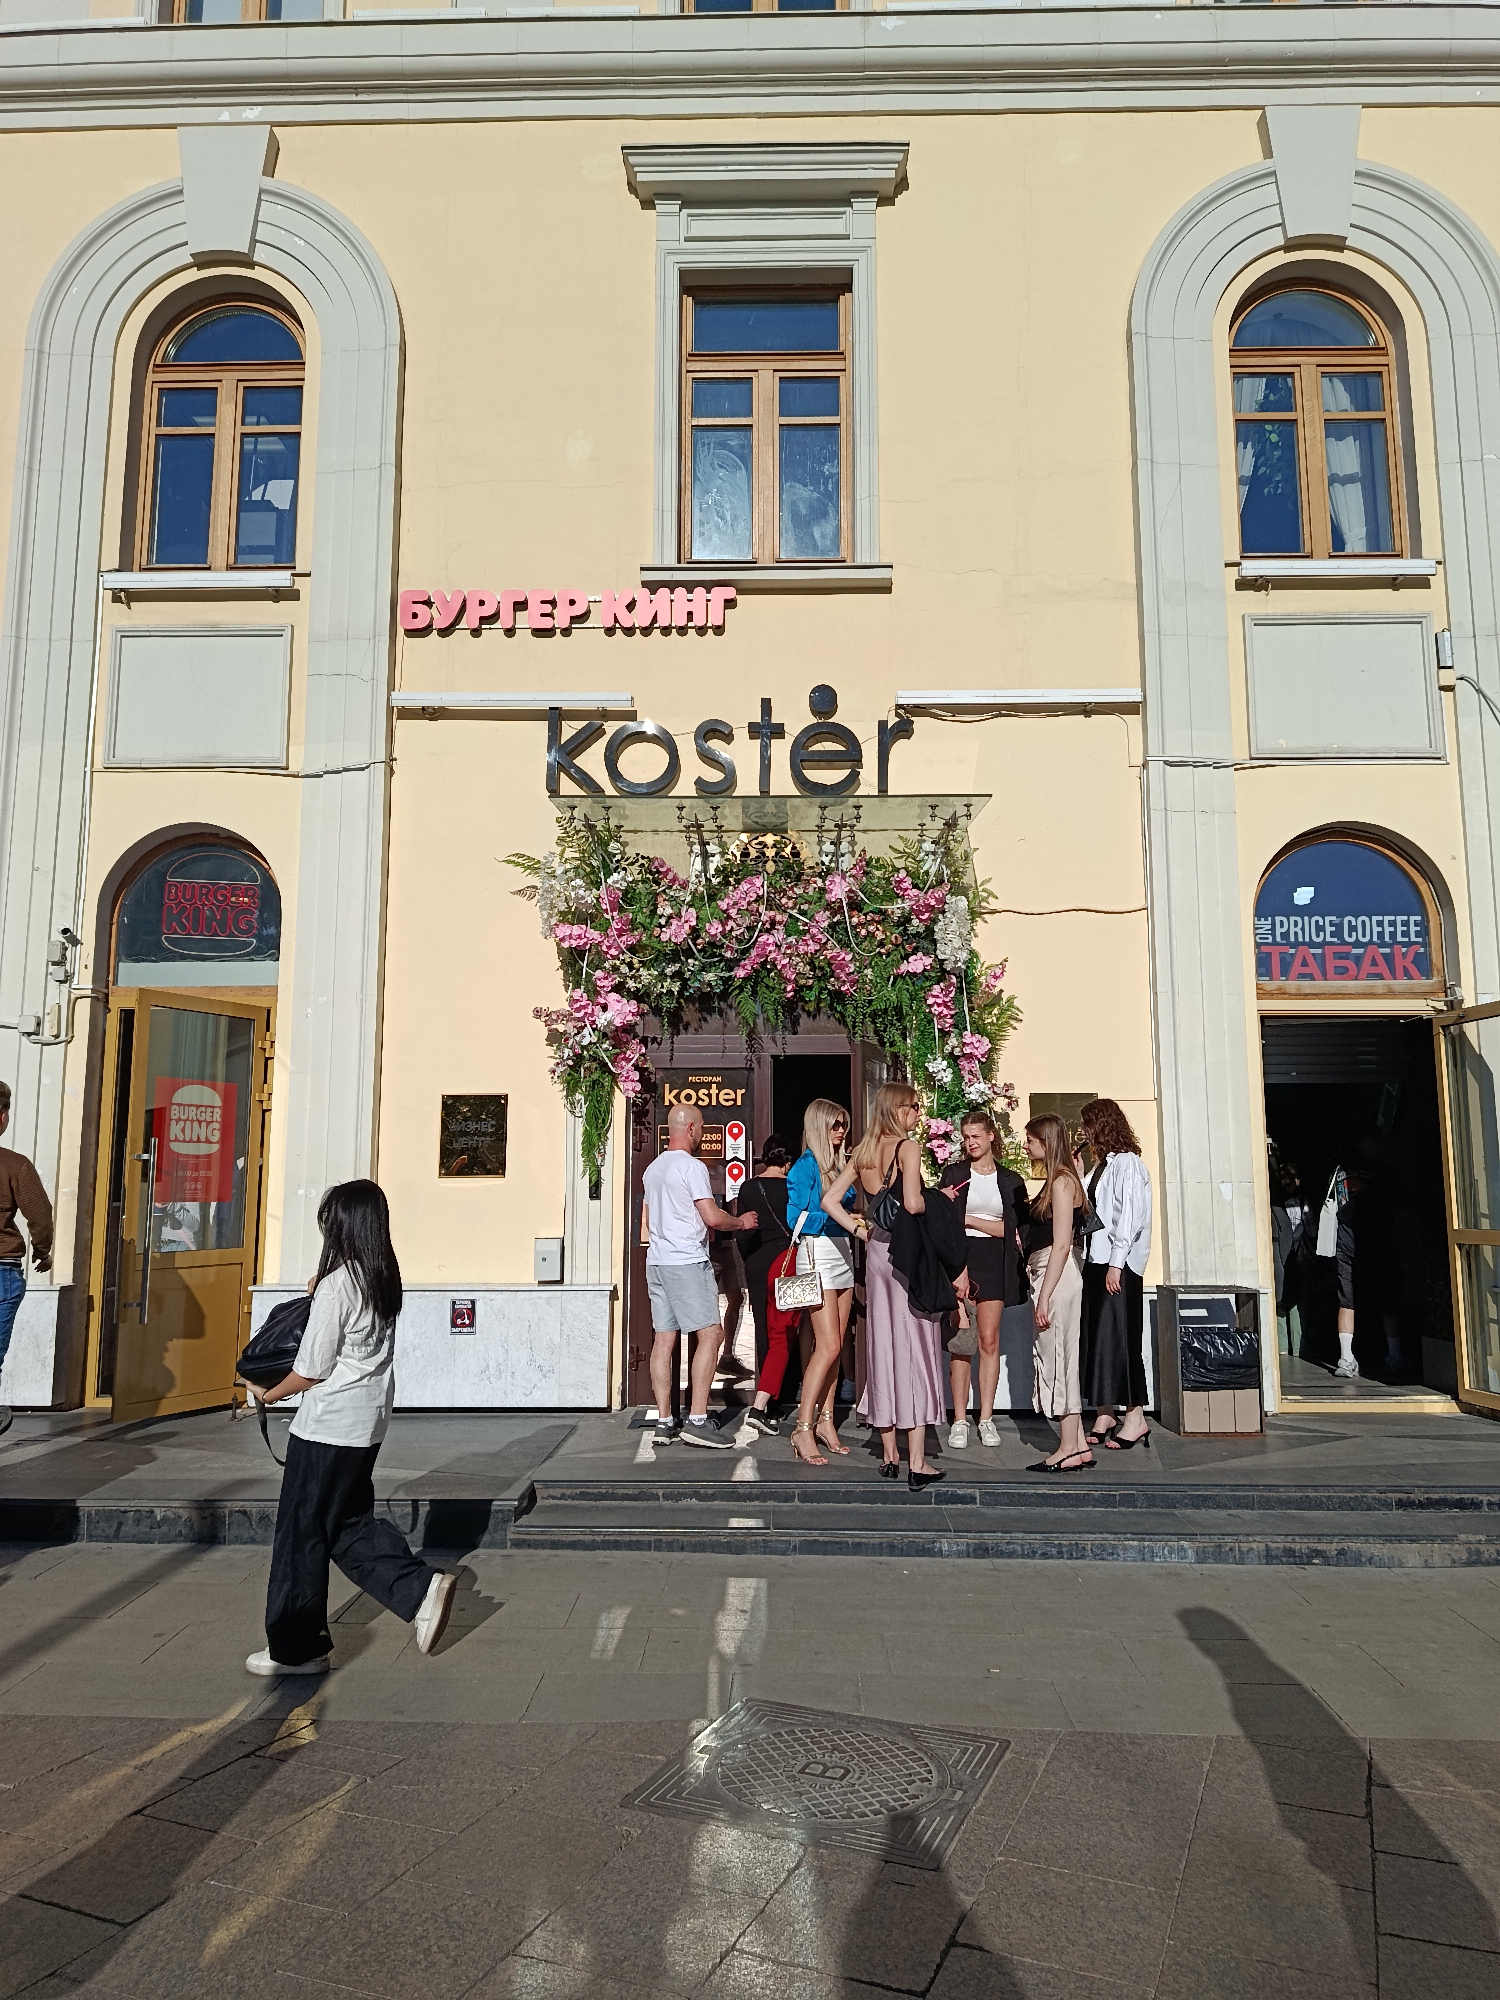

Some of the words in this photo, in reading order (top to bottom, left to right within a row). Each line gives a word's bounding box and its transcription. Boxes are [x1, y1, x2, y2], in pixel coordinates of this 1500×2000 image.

[399, 589, 590, 631] БУРГЕР
[601, 586, 737, 629] КИНГ
[164, 881, 260, 907] BURGER
[162, 904, 258, 937] KING
[1255, 916, 1273, 943] ONE
[1275, 915, 1338, 942] PRICE
[1343, 915, 1423, 942] COFFEE
[1260, 945, 1423, 981] ТАБАК
[688, 1075, 722, 1083] РЕСТОРАН
[664, 1083, 746, 1106] koster
[171, 1105, 221, 1121] BURGER
[170, 1120, 220, 1142] KING
